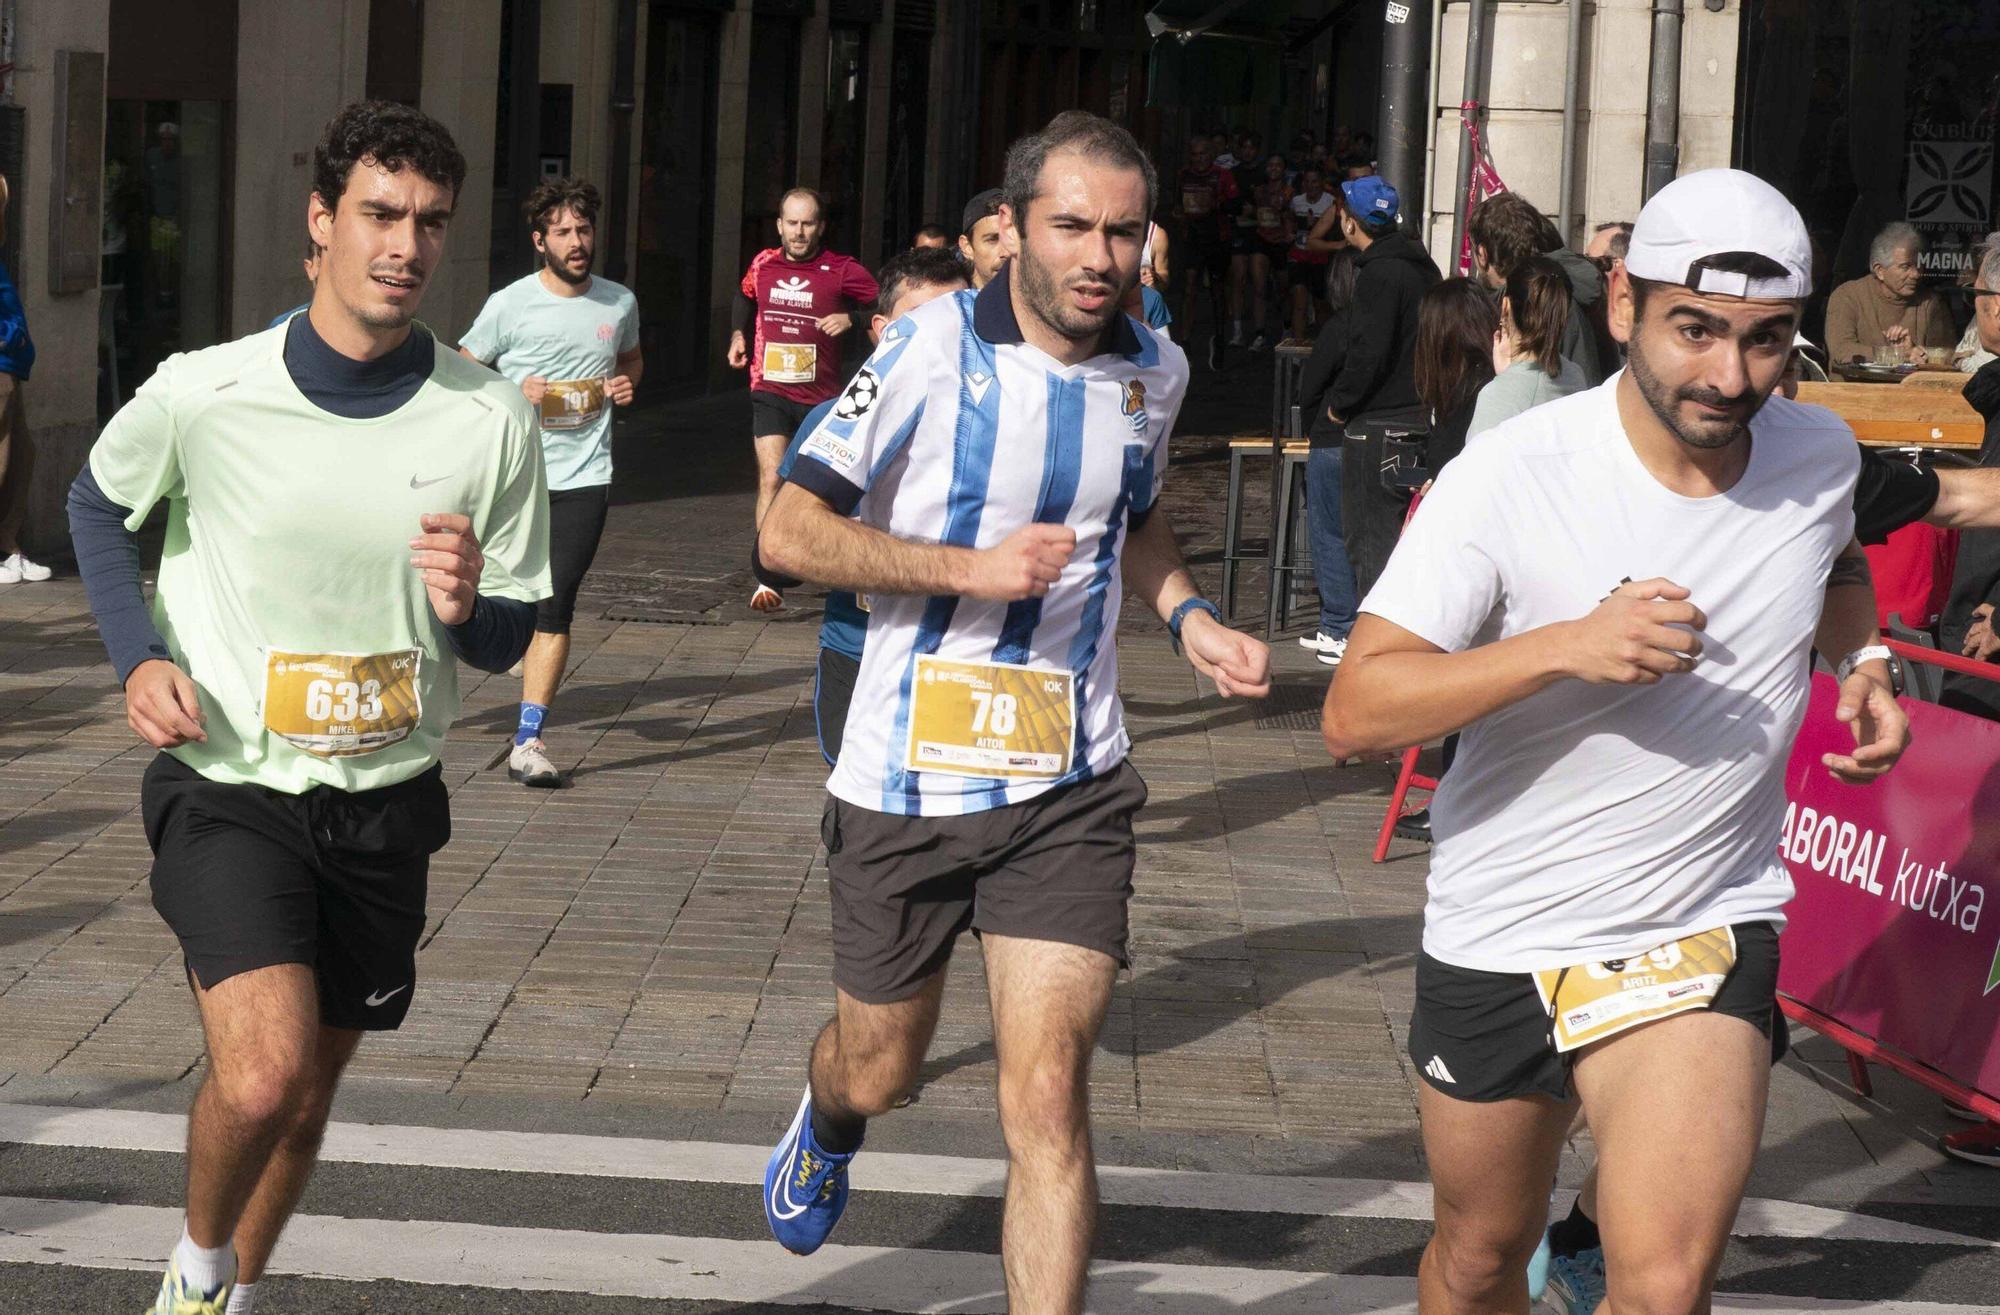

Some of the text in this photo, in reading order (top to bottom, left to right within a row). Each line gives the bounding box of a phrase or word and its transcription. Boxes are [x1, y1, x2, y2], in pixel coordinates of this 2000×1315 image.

[1917, 252, 1973, 270] MAGNA
[781, 353, 797, 369] 12
[562, 390, 589, 412] 191
[391, 656, 410, 670] 10K
[1043, 679, 1063, 694] 10K
[306, 679, 383, 722] 633
[970, 690, 1018, 736] 78
[328, 724, 358, 735] MIKEL
[976, 736, 1006, 750] AITOR
[1890, 847, 1985, 933] kutxa
[1621, 975, 1660, 991] ARITZ
